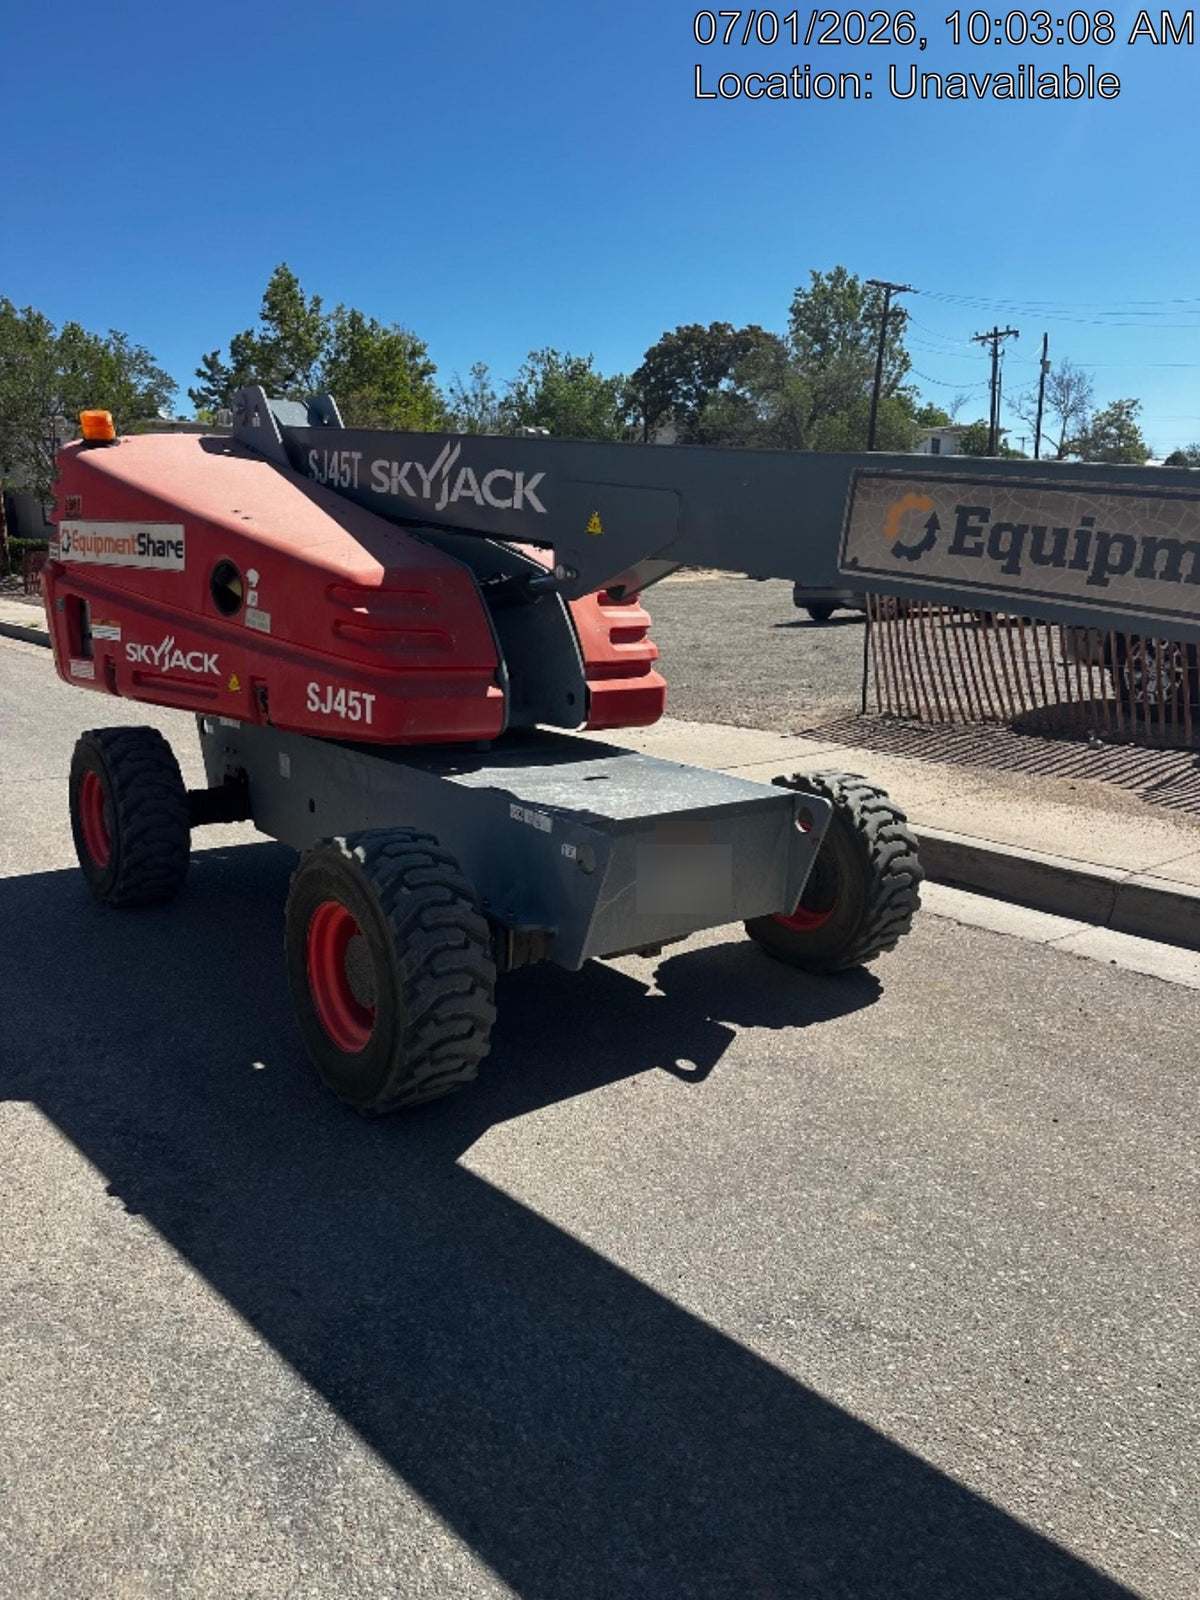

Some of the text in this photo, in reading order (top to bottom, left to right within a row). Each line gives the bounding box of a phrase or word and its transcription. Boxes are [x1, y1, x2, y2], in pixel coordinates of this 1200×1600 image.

[308, 440, 548, 513] SJ45T SKYJACK
[125, 635, 220, 675] SKYJACK
[306, 682, 376, 724] SJ45T
